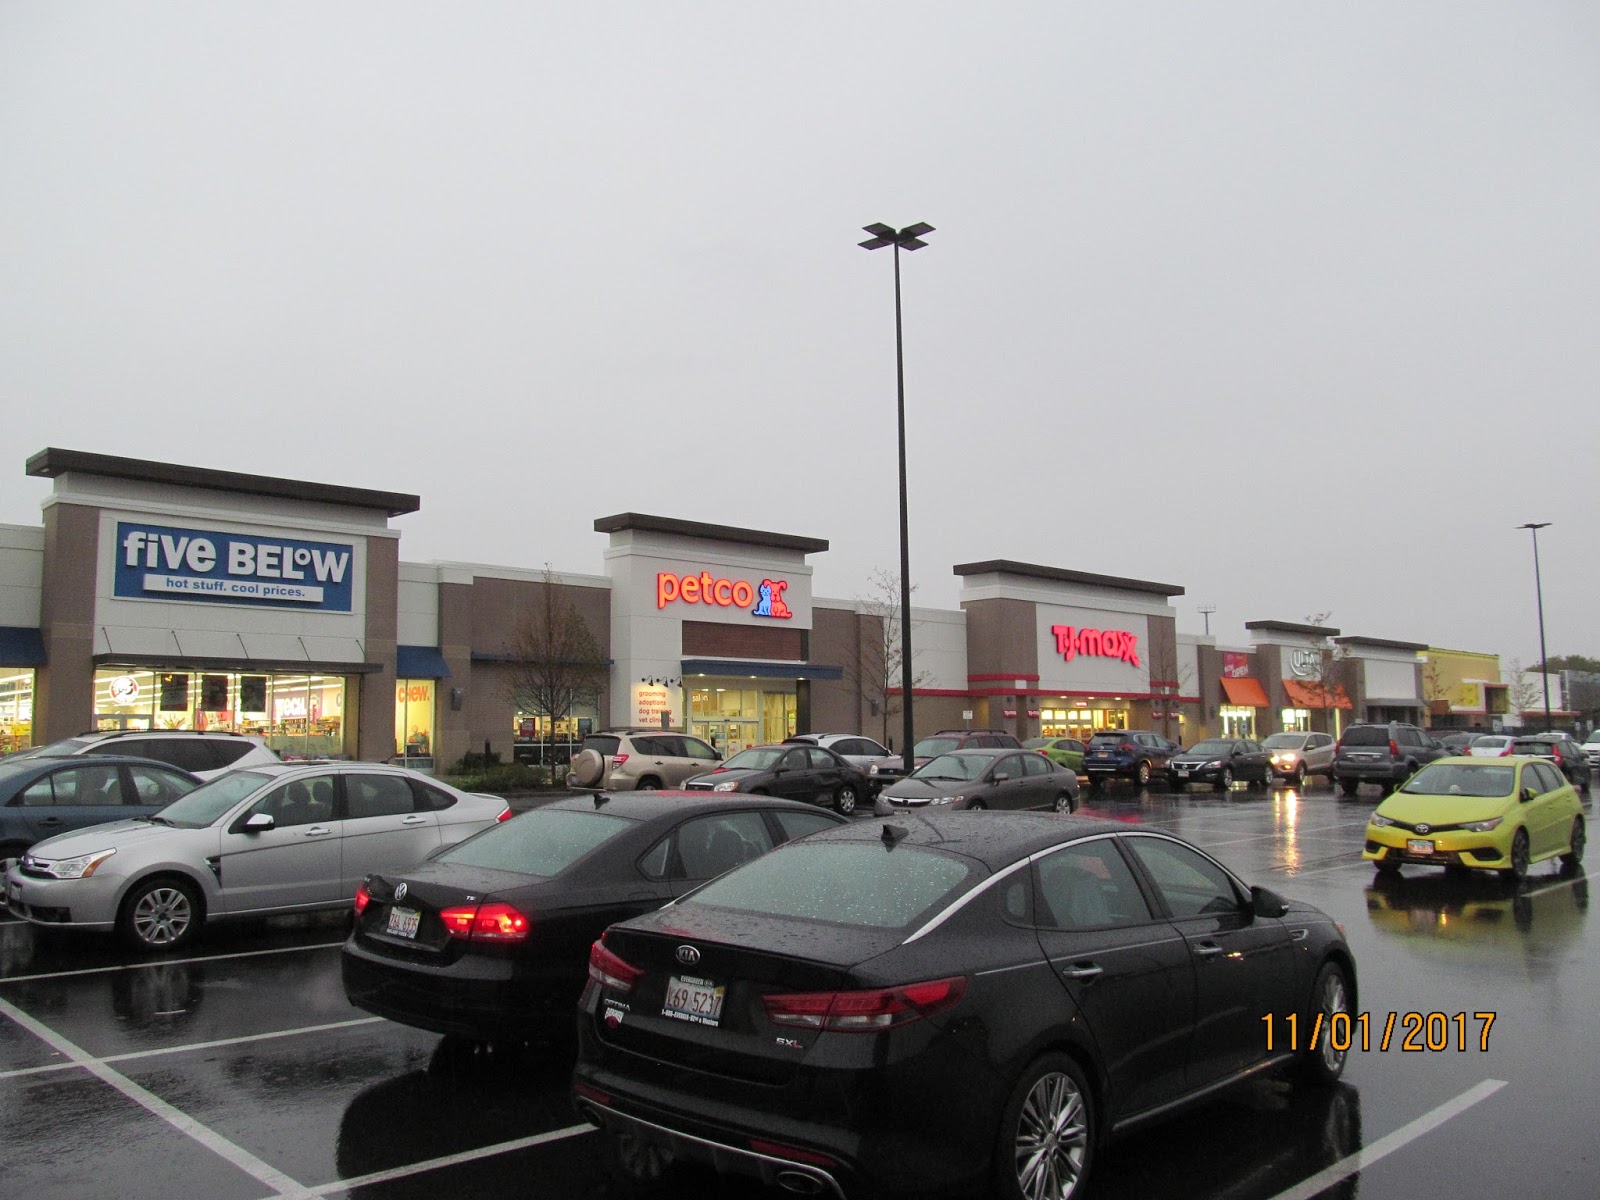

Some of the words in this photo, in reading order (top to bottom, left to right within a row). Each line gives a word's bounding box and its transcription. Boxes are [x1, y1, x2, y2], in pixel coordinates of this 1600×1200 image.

[124, 531, 217, 573] five
[166, 577, 189, 589] hot
[193, 579, 227, 591] stuff.
[231, 583, 259, 594] cool
[263, 584, 306, 598] prices.
[657, 571, 754, 609] petco
[1231, 664, 1249, 678] OPEN
[677, 948, 698, 962] KIA
[692, 991, 722, 1015] 5237
[776, 1037, 803, 1048] SXL
